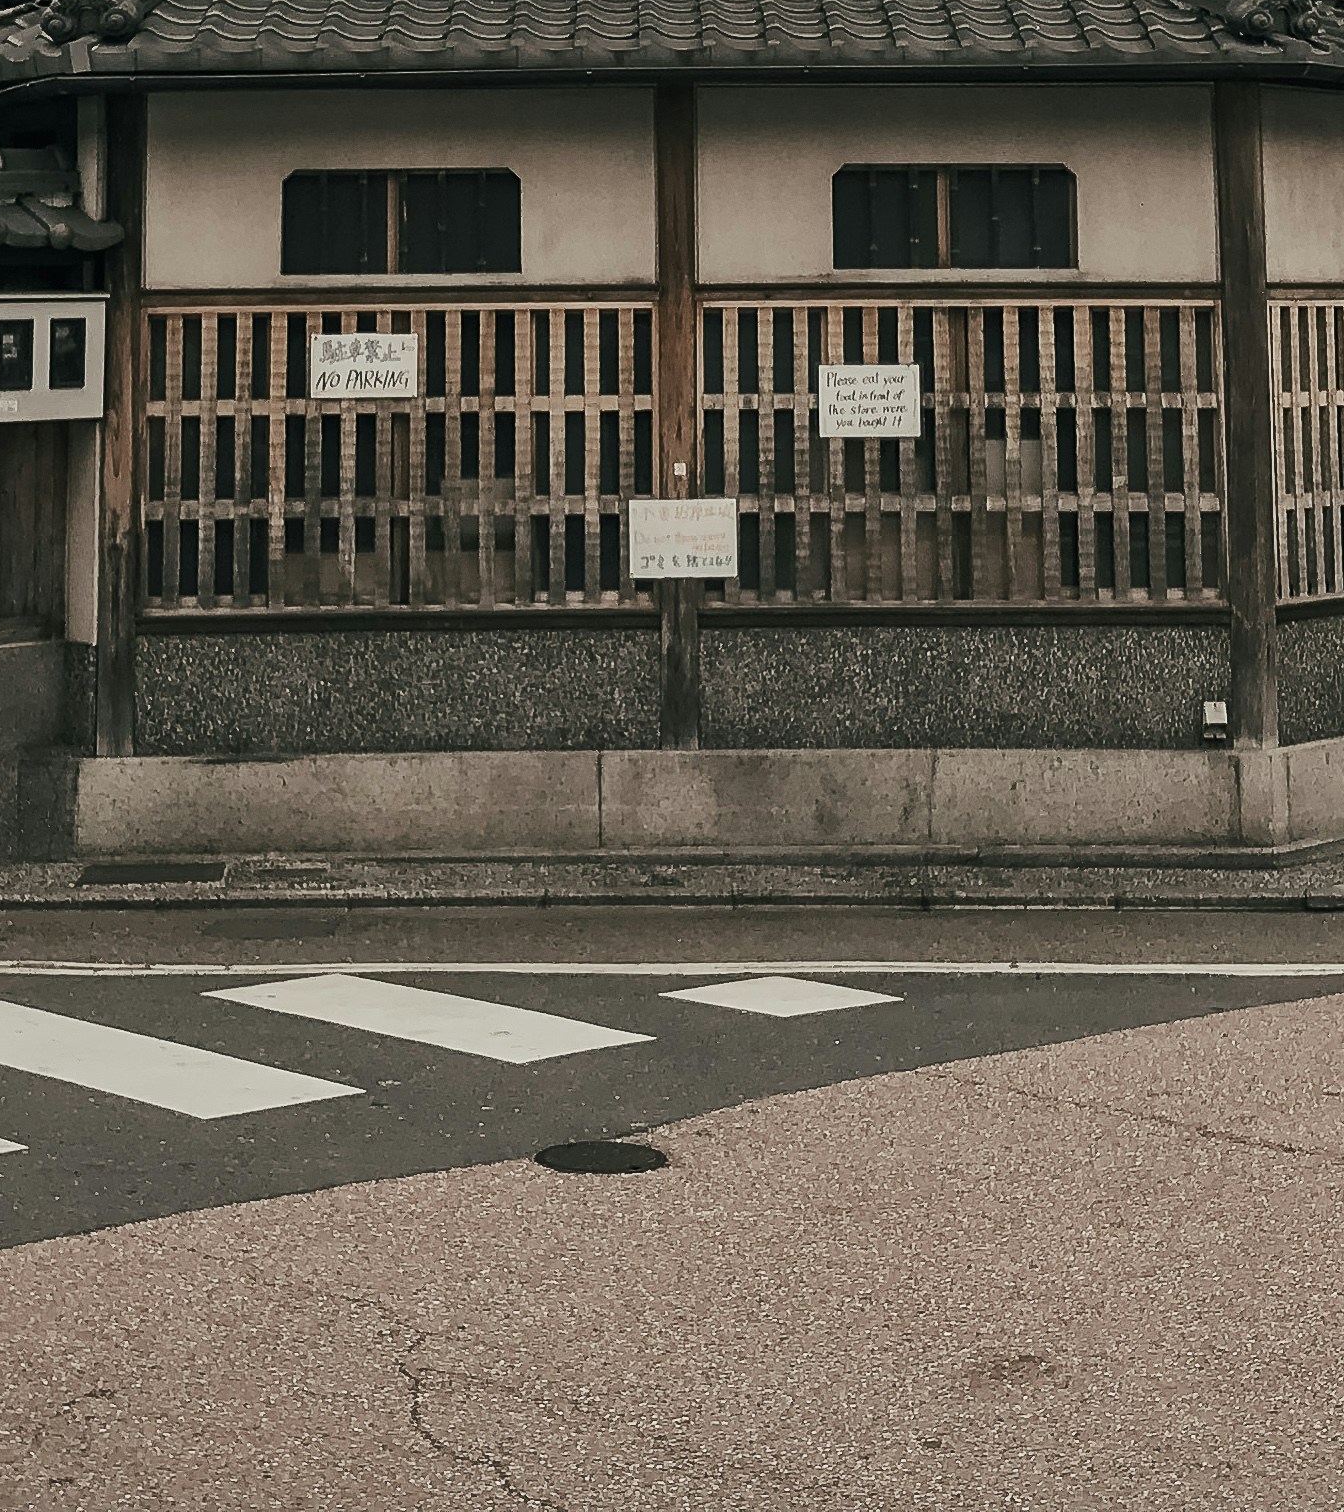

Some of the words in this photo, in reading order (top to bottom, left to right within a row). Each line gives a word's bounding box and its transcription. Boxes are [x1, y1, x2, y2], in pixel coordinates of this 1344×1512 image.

[319, 338, 401, 365] 駐車禁止
[315, 371, 341, 391] NO
[345, 369, 409, 390] PARKING
[826, 371, 858, 387] Please
[862, 372, 879, 385] eat
[884, 375, 907, 388] your
[893, 389, 905, 400] of
[828, 404, 846, 415] the
[851, 404, 877, 415] store
